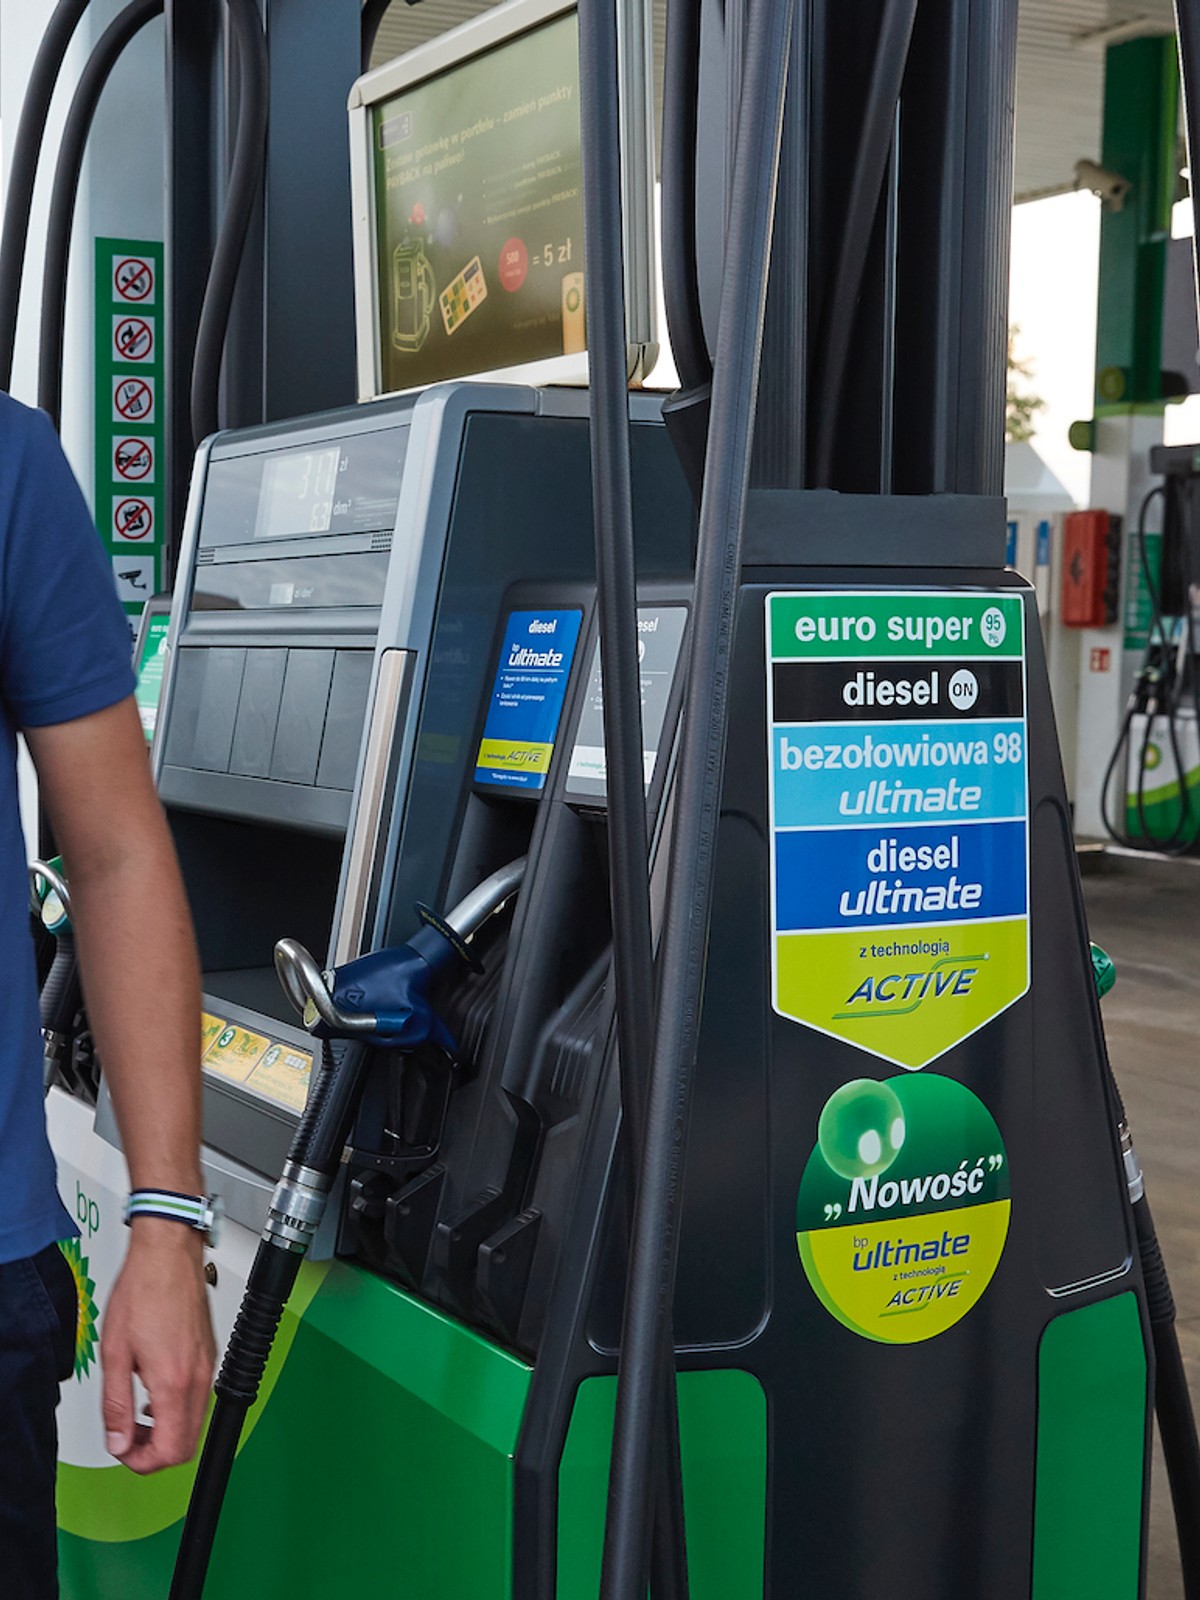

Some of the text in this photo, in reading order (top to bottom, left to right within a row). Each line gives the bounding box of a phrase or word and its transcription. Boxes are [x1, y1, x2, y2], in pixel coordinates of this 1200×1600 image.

[538, 85, 572, 112] punkty
[544, 243, 553, 266] 5
[558, 237, 572, 263] zł
[528, 618, 557, 634] diesel
[637, 617, 658, 632] esel
[795, 615, 973, 649] euro super
[985, 613, 1002, 631] 95
[508, 648, 563, 667] ultimate
[843, 671, 939, 706] diesel
[952, 681, 973, 698] ON
[507, 750, 542, 763] ACTIVE
[780, 731, 1022, 771] bezołowiowa 98
[839, 778, 982, 816] ultimate
[867, 836, 959, 873] diesel
[839, 876, 982, 916] ultimate
[859, 938, 950, 958] z technologią
[845, 968, 978, 1006] ACTIVE
[219, 1029, 235, 1046] 3
[77, 1180, 99, 1239] bp
[853, 1236, 869, 1250] bp
[853, 1231, 970, 1272] ultimate
[886, 1280, 962, 1309] ACTIVE
